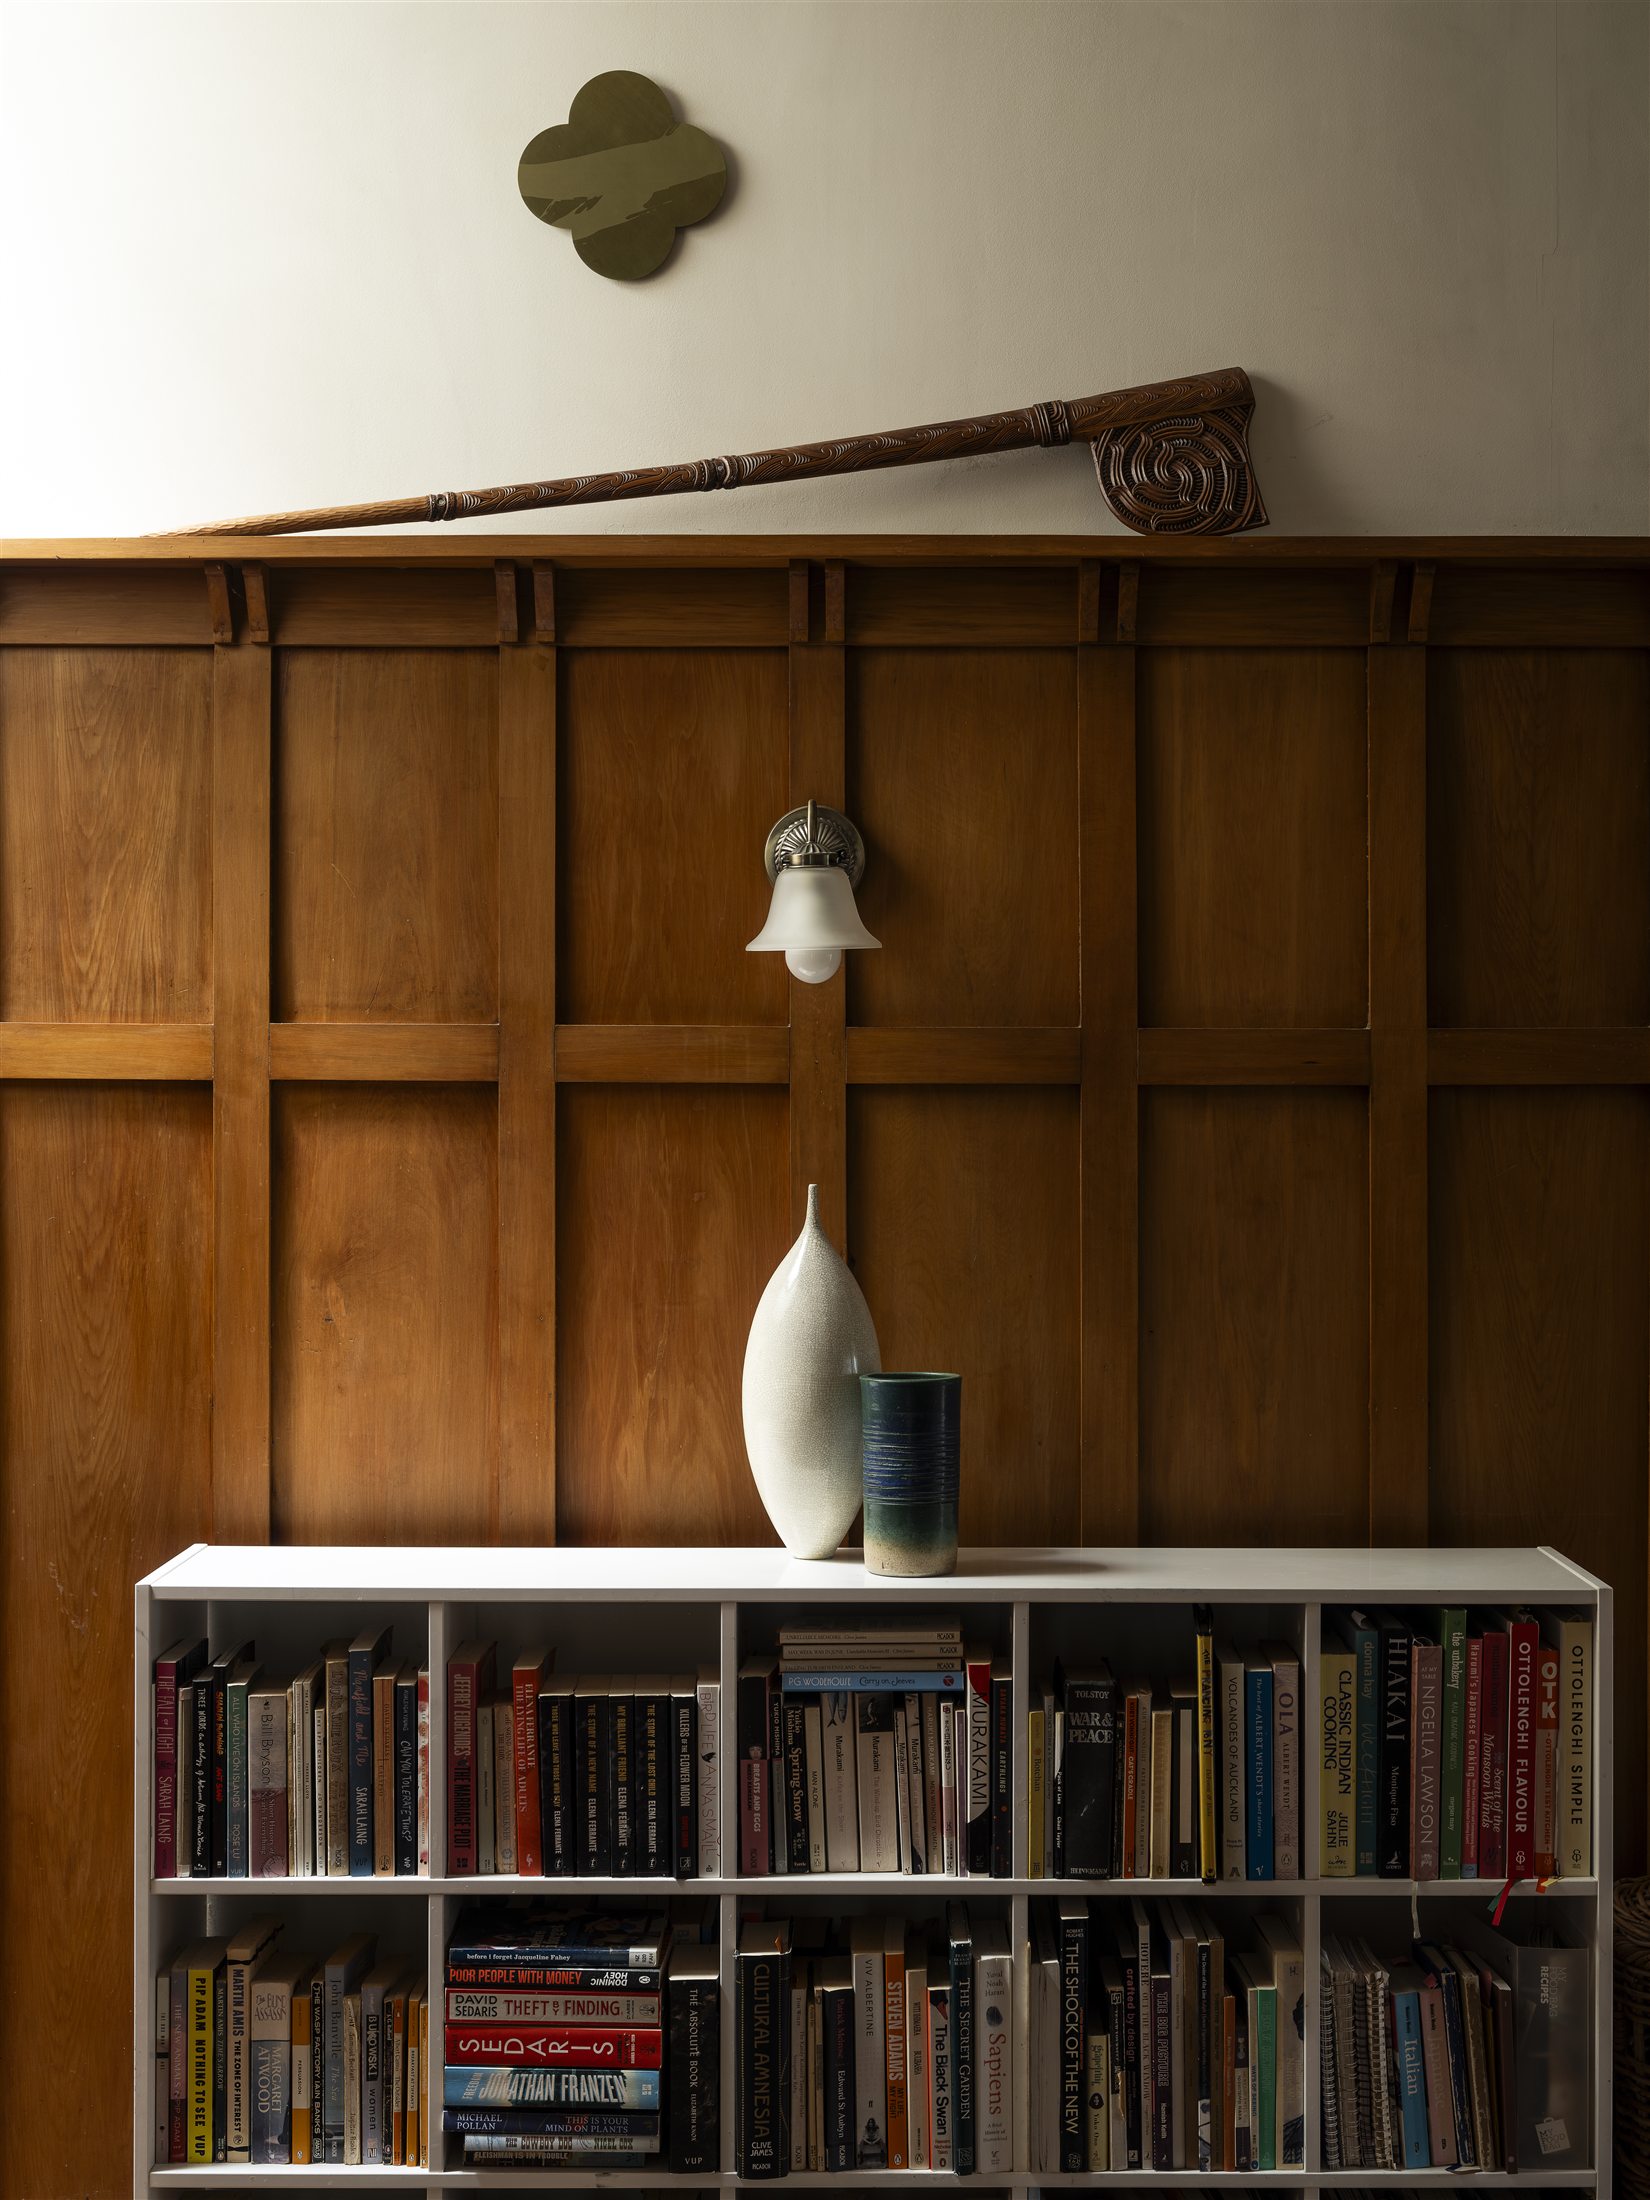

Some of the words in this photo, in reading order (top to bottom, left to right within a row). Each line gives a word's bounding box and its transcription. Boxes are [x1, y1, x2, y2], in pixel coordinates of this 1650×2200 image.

[1452, 1632, 1464, 1647] the
[1362, 1641, 1375, 1676] donna
[1447, 1650, 1463, 1689] unbakery
[1470, 1644, 1481, 1687] Harumi's
[157, 1675, 174, 1692] THE
[453, 1674, 470, 1708] JEFFREY
[804, 1677, 852, 1686] WODEHOUSE
[1075, 1690, 1110, 1699] TOLSTOY
[1362, 1679, 1375, 1699] hay
[1386, 1638, 1408, 1742] HIAKAI
[1518, 1642, 1530, 1750] OTTOLENGHI
[1541, 1662, 1558, 1720] OTK
[157, 1696, 174, 1718] FALL
[232, 1697, 240, 1713] ALL
[617, 1705, 626, 1716] MY
[1228, 1677, 1238, 1742] VOLCANOES
[1278, 1692, 1294, 1736] OLA
[1339, 1670, 1352, 1735] CLASSIC
[1467, 1690, 1479, 1734] Japanese
[1571, 1645, 1583, 1756] OTTOLENGHI
[232, 1714, 240, 1736] WHO
[261, 1714, 273, 1738] Bill
[453, 1711, 470, 1756] EUGENIDES
[680, 1708, 690, 1738] KILLERS
[1069, 1712, 1099, 1726] WAR
[1101, 1712, 1114, 1726] &
[1324, 1696, 1337, 1770] COOKING
[1420, 1686, 1435, 1758] NIGELLA
[157, 1727, 174, 1754] LIGHT
[232, 1738, 240, 1756] LIVE
[401, 1740, 411, 1758] CAN
[617, 1718, 626, 1754] BRILLIANT
[972, 1692, 988, 1805] MURAKAMI
[1068, 1730, 1114, 1744] PEACE
[232, 1758, 240, 1771] ON
[260, 1739, 273, 1784] Bryson
[401, 1759, 411, 1774] YOU
[680, 1754, 690, 1782] FLOWER
[790, 1748, 802, 1788] Spring
[835, 1736, 844, 1772] Murakami
[872, 1736, 882, 1772] Murakami
[1228, 1745, 1238, 1760] OF
[1282, 1742, 1290, 1774] ALBERT
[1339, 1740, 1352, 1794] INDIAN
[1465, 1738, 1477, 1777] Cooking
[454, 1766, 470, 1782] THE
[617, 1756, 626, 1782] FRIEND
[158, 1776, 172, 1808] SARAH
[232, 1773, 240, 1808] ISLANDS
[401, 1777, 411, 1816] TOLERATE
[618, 1787, 627, 1808] ELENA
[680, 1784, 690, 1807] MOON
[930, 1780, 938, 1794] MEN
[1228, 1762, 1238, 1822] AUCKLAND
[1282, 1779, 1290, 1809] WENDT
[1390, 1765, 1400, 1806] Monique
[1515, 1758, 1528, 1833] FLAVOUR
[1571, 1764, 1583, 1825] SIMPLE
[454, 1784, 470, 1827] MARRIAGE
[793, 1790, 803, 1822] Snow
[930, 1796, 938, 1824] WITHOUT
[1390, 1807, 1400, 1826] Fiso
[1420, 1766, 1435, 1844] LAWSON
[158, 1813, 172, 1844] LAING
[232, 1824, 240, 1846] ROSE
[401, 1817, 411, 1842] THIS?
[454, 1829, 470, 1849] PLOT
[618, 1811, 627, 1847] FERRANTE
[930, 1826, 938, 1850] WOMEN
[1327, 1810, 1337, 1848] SAHNI
[1338, 1812, 1348, 1847] JULIE
[232, 1848, 240, 1859] LU
[866, 1959, 874, 1976] VIV
[1066, 1943, 1078, 1974] THE
[196, 1978, 206, 1996] PIP
[232, 1969, 244, 2007] MARTIN
[450, 1969, 476, 1982] POOR
[478, 1970, 516, 1983] PEOPLE
[518, 1970, 544, 1984] WITH
[546, 1971, 582, 1985] MONEY
[604, 1972, 628, 1980] HOEY
[1126, 1968, 1136, 2009] crafted
[1540, 1966, 1549, 2004] RECIPES
[1549, 1966, 1558, 1994] FOOD
[1559, 1967, 1568, 1982] MY
[456, 1994, 498, 2004] DAVID
[689, 1989, 698, 2006] THE
[754, 1963, 770, 2049] CULTURAL
[887, 1982, 902, 2030] STEVEN
[960, 1978, 971, 2006] THE
[1066, 1978, 1078, 2034] SHOCK
[1158, 1992, 1168, 2014] THE
[1549, 1997, 1558, 2016] BAG
[196, 1998, 206, 2032] ADAM
[232, 2010, 244, 2036] AMIS
[456, 2006, 498, 2017] SEDARIS
[504, 2000, 550, 2016] THEFT
[866, 1980, 874, 2036] ALBERTINE
[1126, 2012, 1136, 2026] by
[689, 2009, 698, 2057] ABSOLUTE
[936, 2024, 948, 2050] The
[960, 2012, 971, 2060] SECRET
[1158, 2016, 1168, 2036] BIG
[234, 2040, 242, 2056] THE
[460, 2038, 614, 2056] SEDARIS
[888, 2034, 904, 2080] ADAMS
[1066, 2036, 1078, 2060] OF
[1126, 2028, 1136, 2062] design
[195, 2039, 206, 2086] NOTHING
[234, 2058, 242, 2080] ZONE
[689, 2060, 698, 2088] BOOK
[936, 2055, 948, 2092] Black
[984, 2033, 1006, 2115] Sapiens
[1066, 2060, 1078, 2092] THE
[1158, 2038, 1168, 2087] PICTURE
[1404, 2038, 1421, 2096] Italian
[1428, 2036, 1445, 2108] Japanese
[234, 2082, 242, 2092] OF
[258, 2046, 270, 2113] ATWOOD
[272, 2046, 282, 2114] MARGARET
[479, 2073, 556, 2101] JONATHAN
[562, 2074, 627, 2103] FRANZEN
[754, 2052, 770, 2138] AMNESIA
[960, 2064, 971, 2120] GARDEN
[195, 2092, 206, 2104] TO
[234, 2094, 242, 2132] INTEREST
[368, 2088, 376, 2130] women
[195, 2106, 206, 2126] SEE
[456, 2114, 502, 2122] MICHAEL
[456, 2122, 496, 2130] POLLAN
[545, 2124, 572, 2133] MIND
[574, 2124, 588, 2133] ON
[590, 2124, 628, 2133] PLANTS
[566, 2116, 588, 2125] THIS
[591, 2116, 600, 2125] IS
[602, 2116, 629, 2125] YOUR
[936, 2096, 948, 2136] Swan
[1066, 2096, 1078, 2134] NEW
[195, 2135, 206, 2156] VUP
[750, 2149, 774, 2157] JAMES
